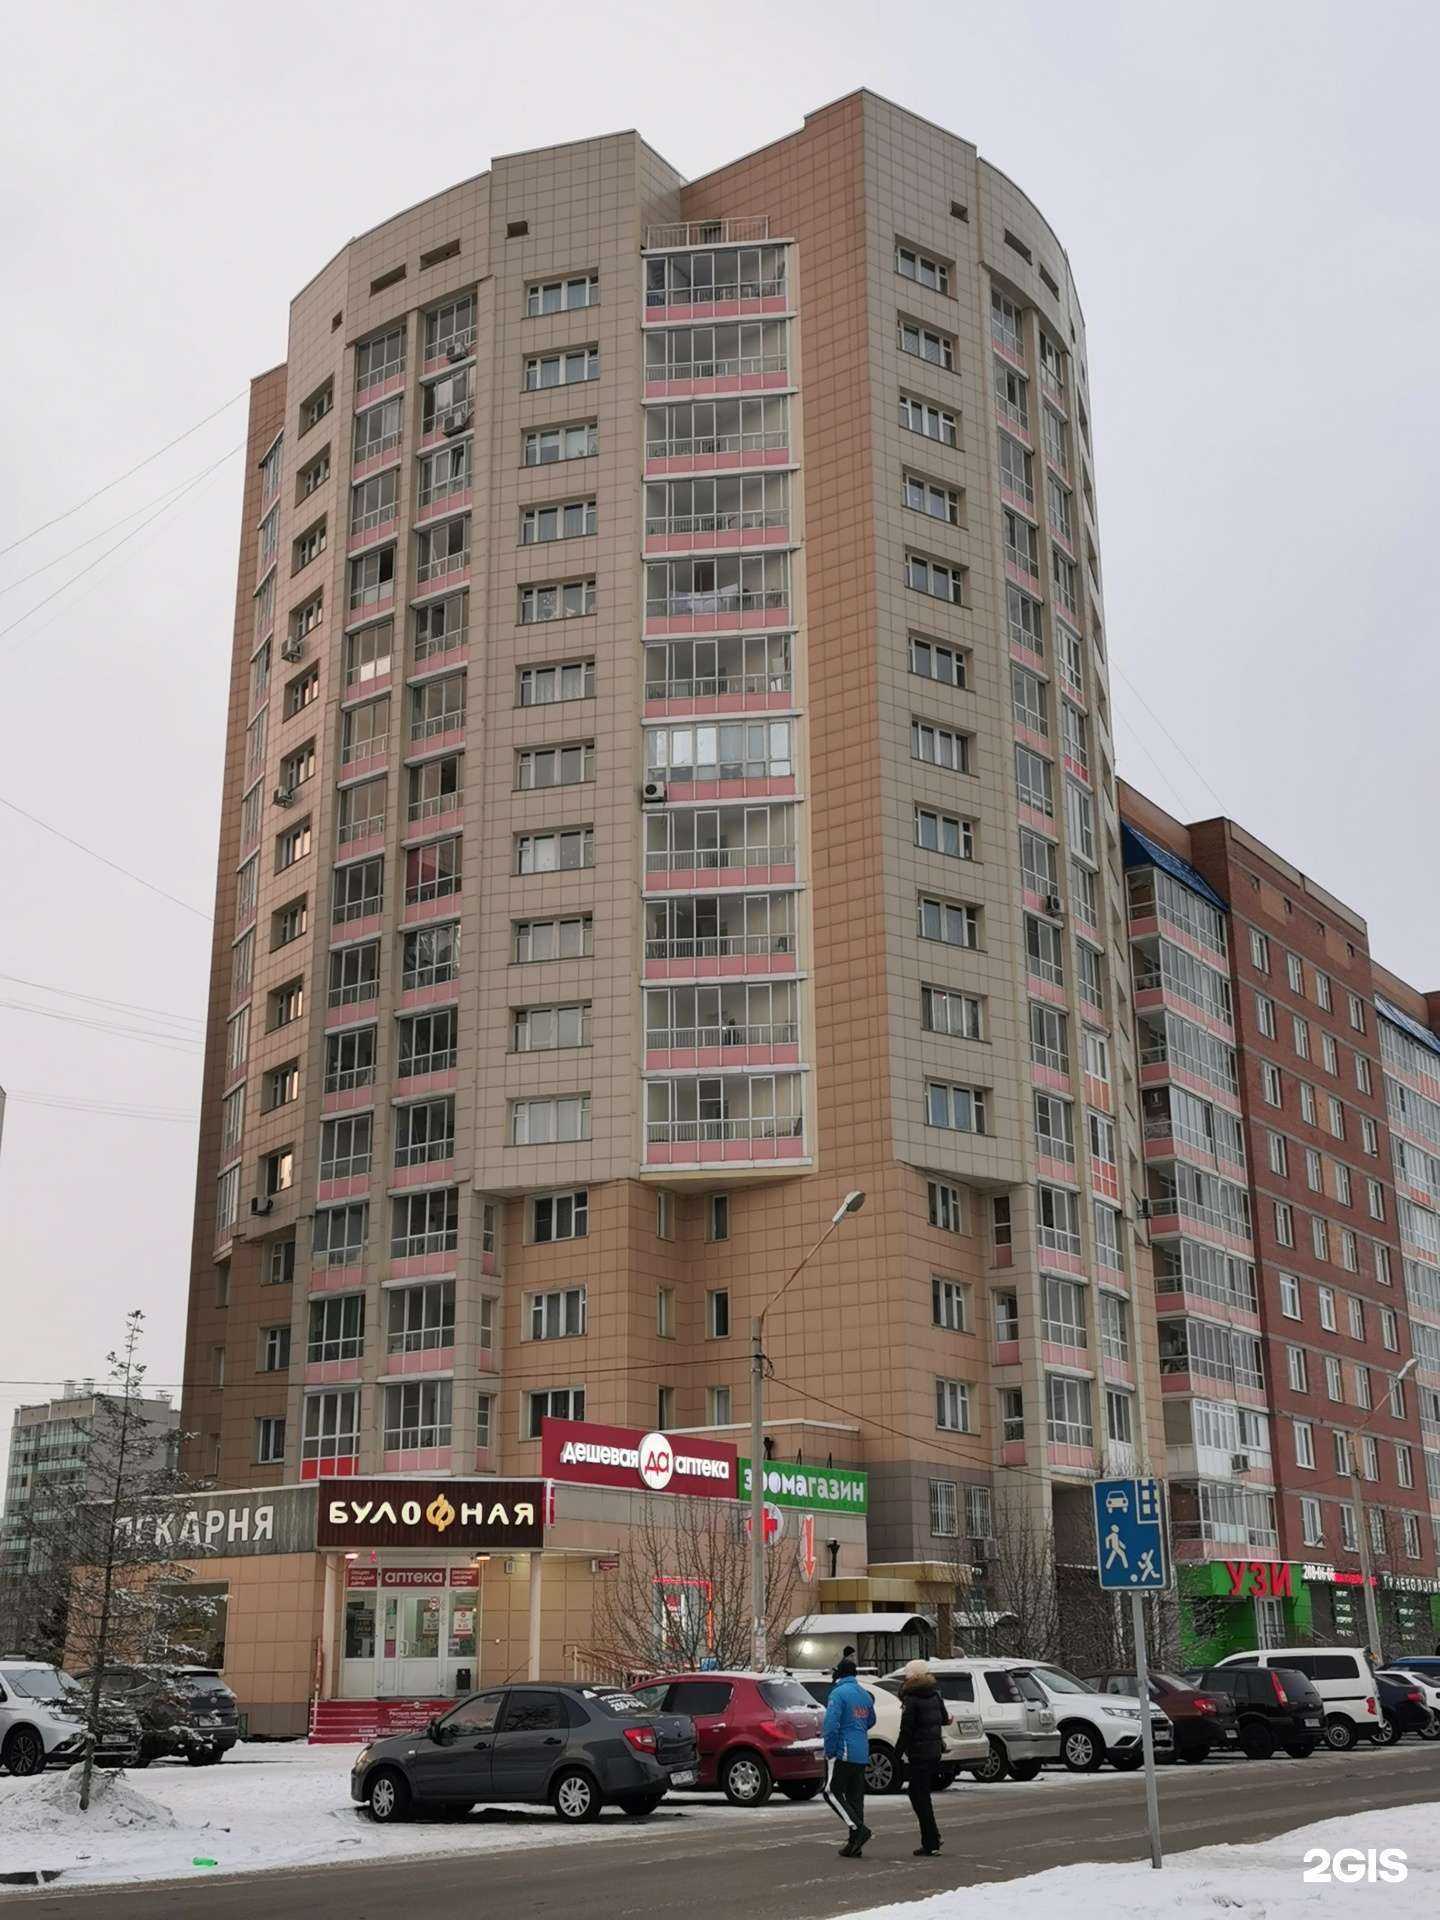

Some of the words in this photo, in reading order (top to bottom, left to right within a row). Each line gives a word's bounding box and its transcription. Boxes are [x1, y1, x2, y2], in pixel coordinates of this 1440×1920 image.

[674, 1455, 730, 1480] аптека
[384, 1571, 444, 1585] аптека
[1225, 1561, 1293, 1598] УЗИ
